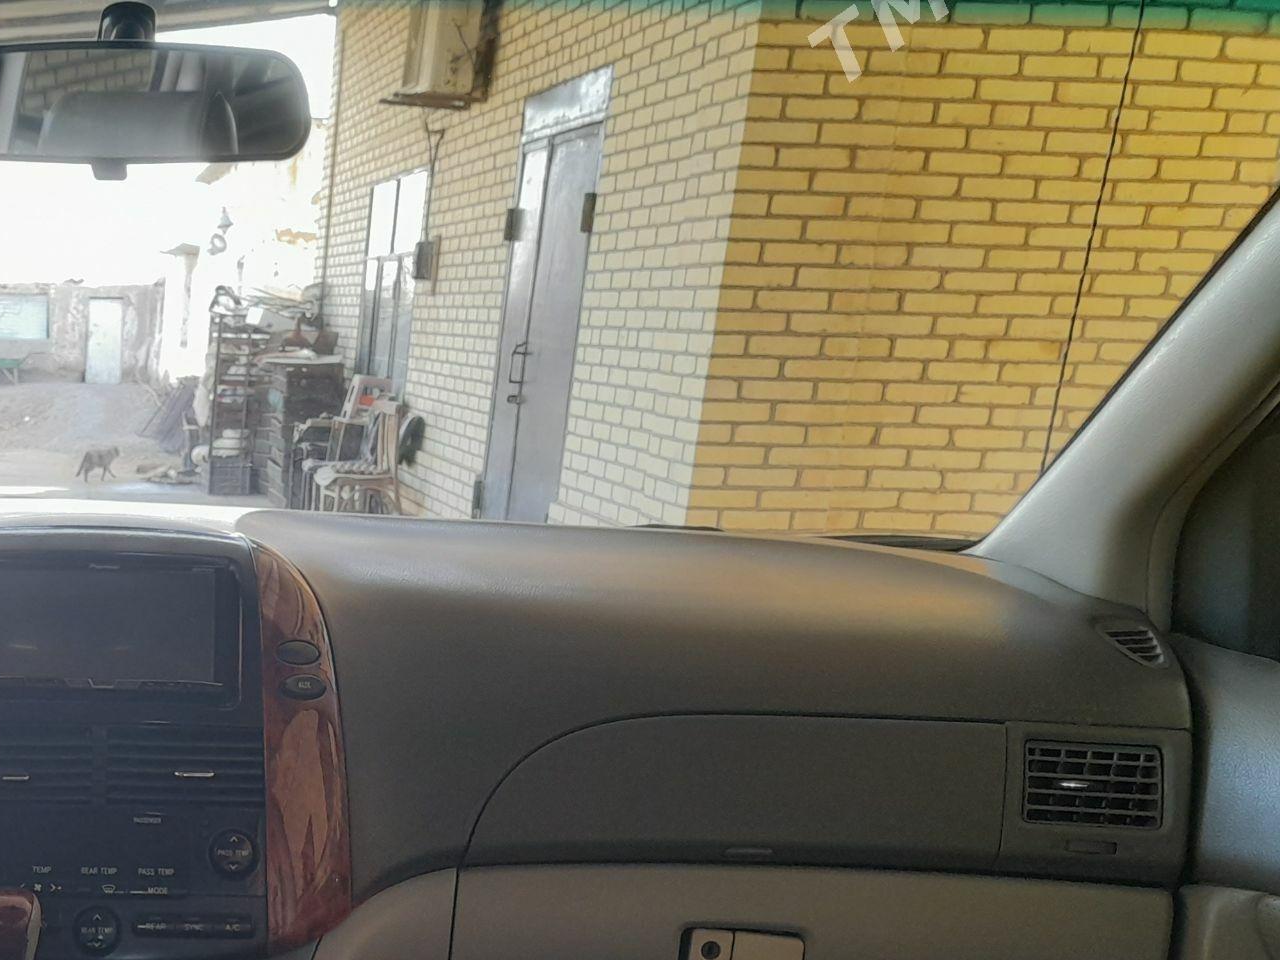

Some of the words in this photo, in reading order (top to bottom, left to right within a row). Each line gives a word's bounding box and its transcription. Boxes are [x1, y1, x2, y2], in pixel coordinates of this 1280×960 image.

[32, 865, 52, 874] TEMP
[100, 866, 118, 876] TEMP
[137, 866, 154, 876] PASS
[147, 886, 169, 896] MODE
